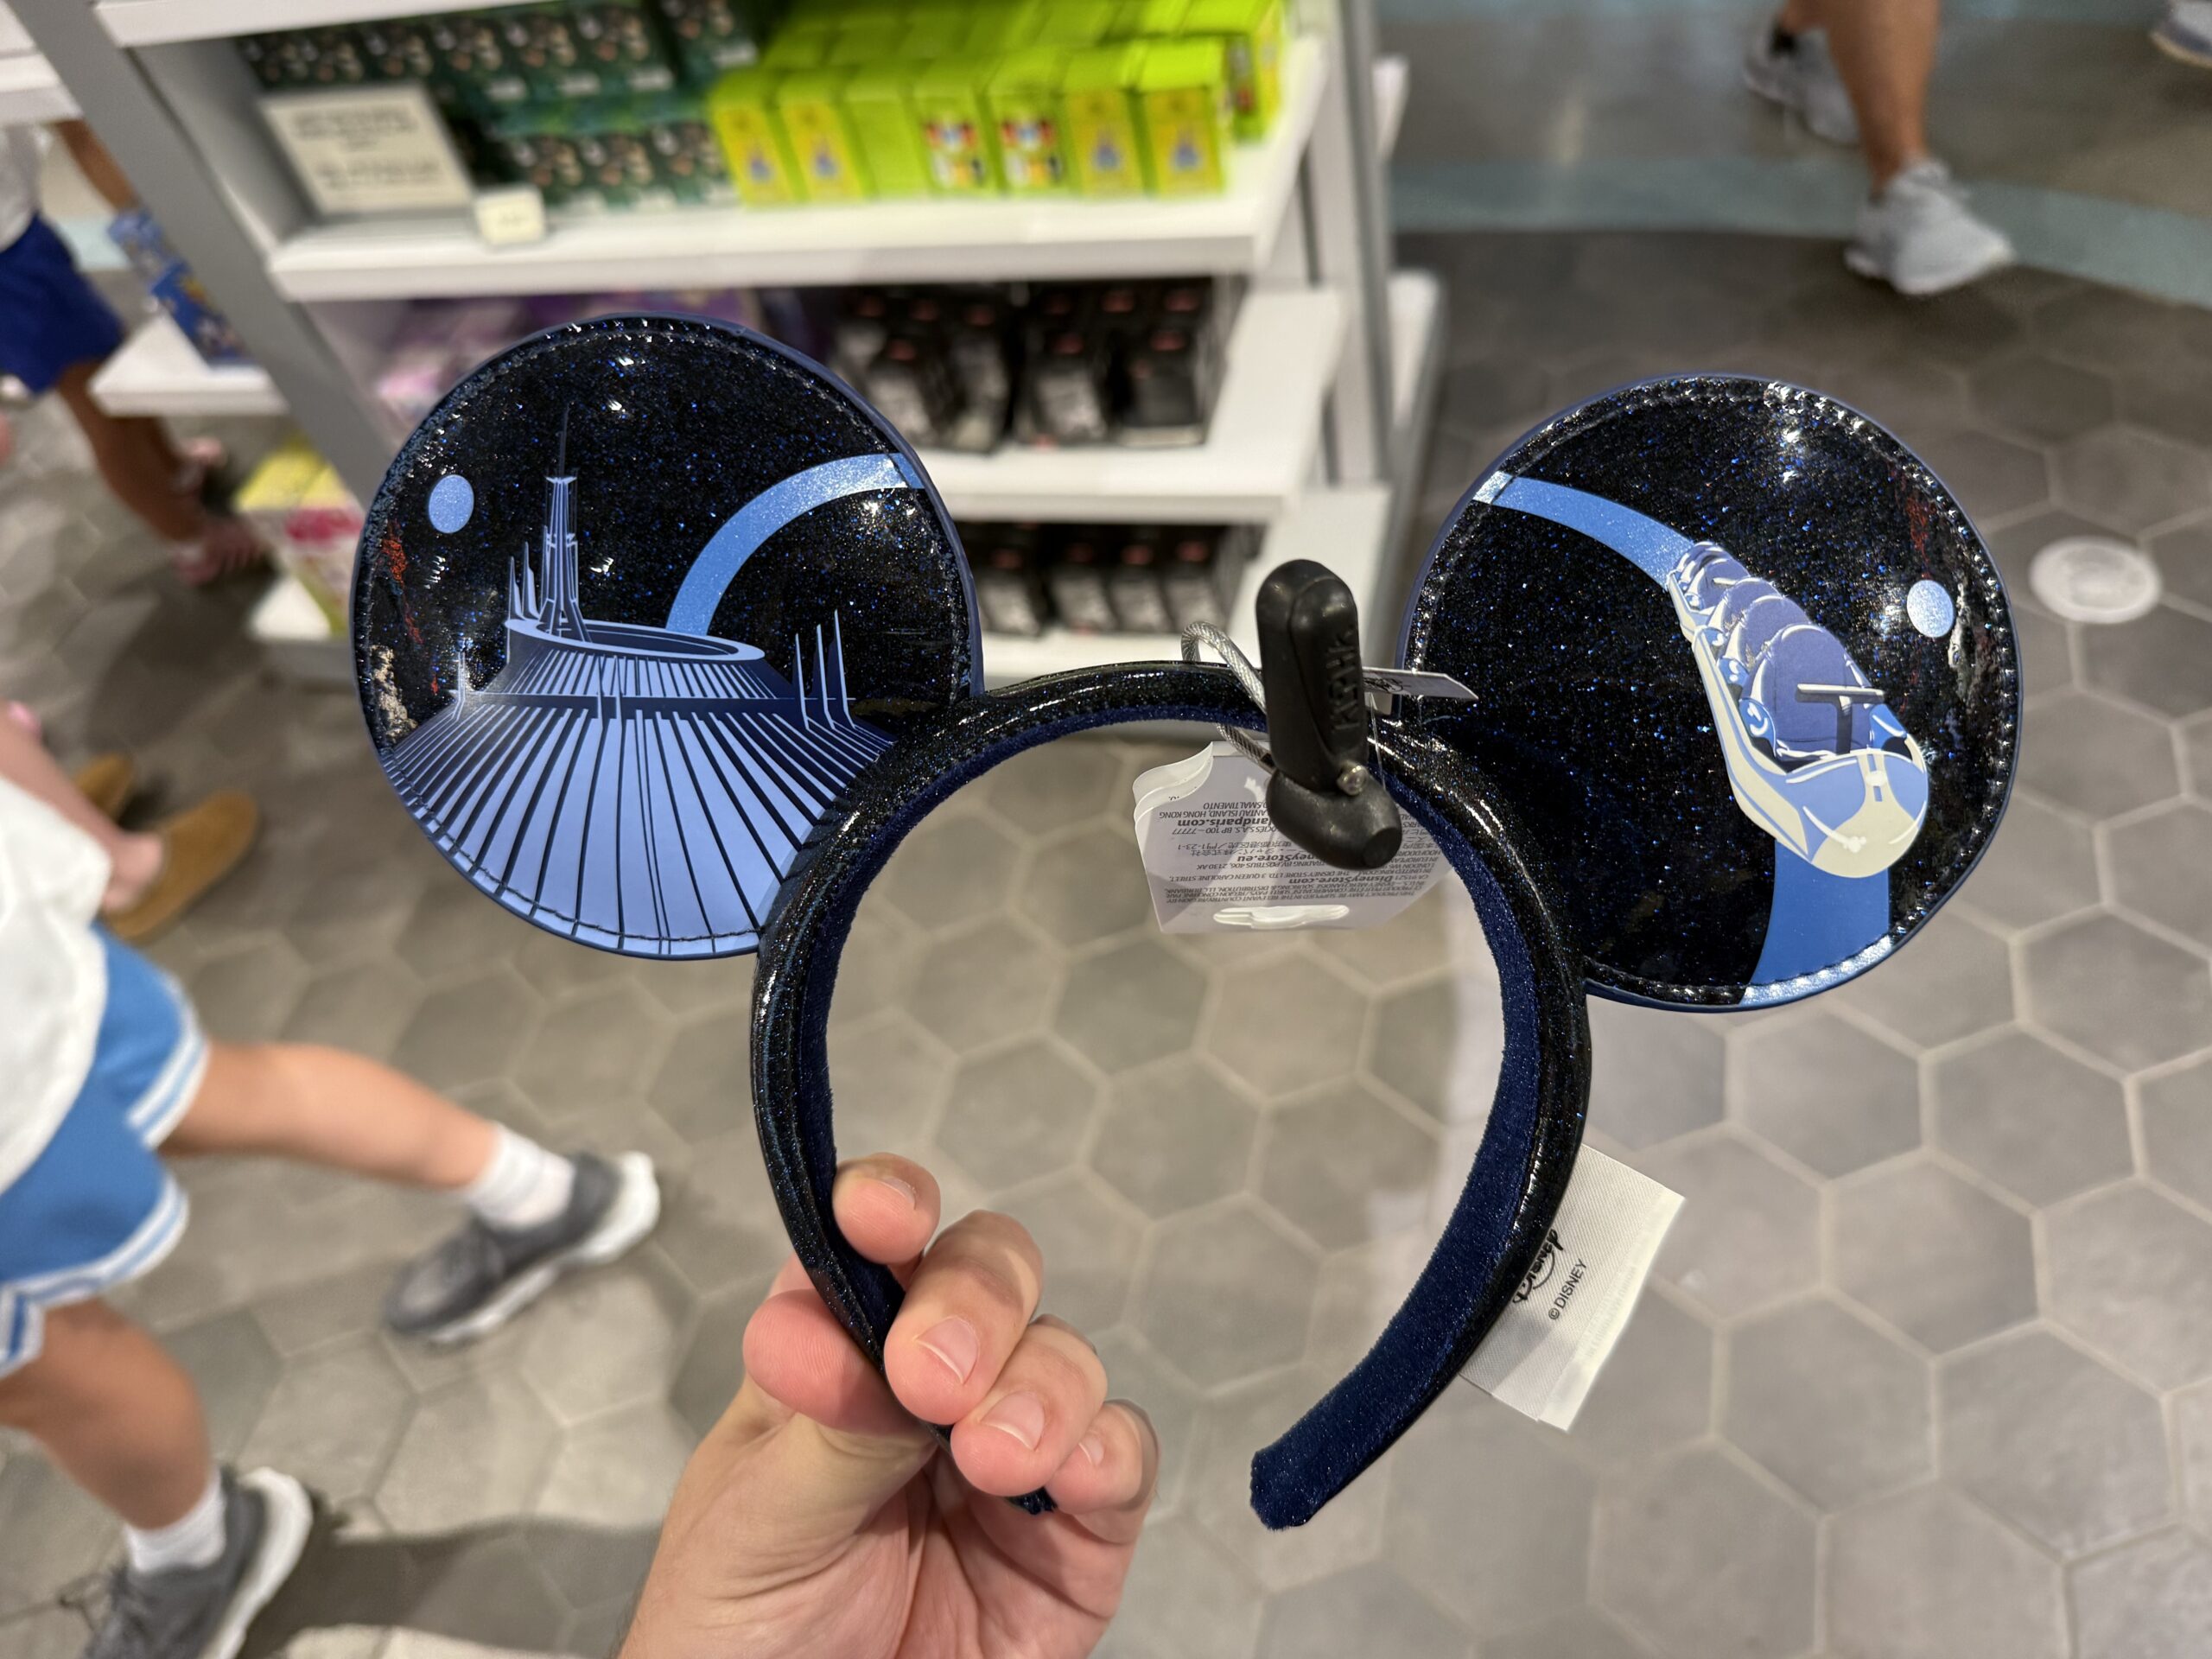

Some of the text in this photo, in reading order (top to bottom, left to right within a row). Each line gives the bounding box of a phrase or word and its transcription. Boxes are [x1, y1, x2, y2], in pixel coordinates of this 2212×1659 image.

[1178, 817, 1271, 827] landparis.com
[1237, 853, 1314, 862] neyStore.eu
[1289, 872, 1393, 884] DisneyStore.com
